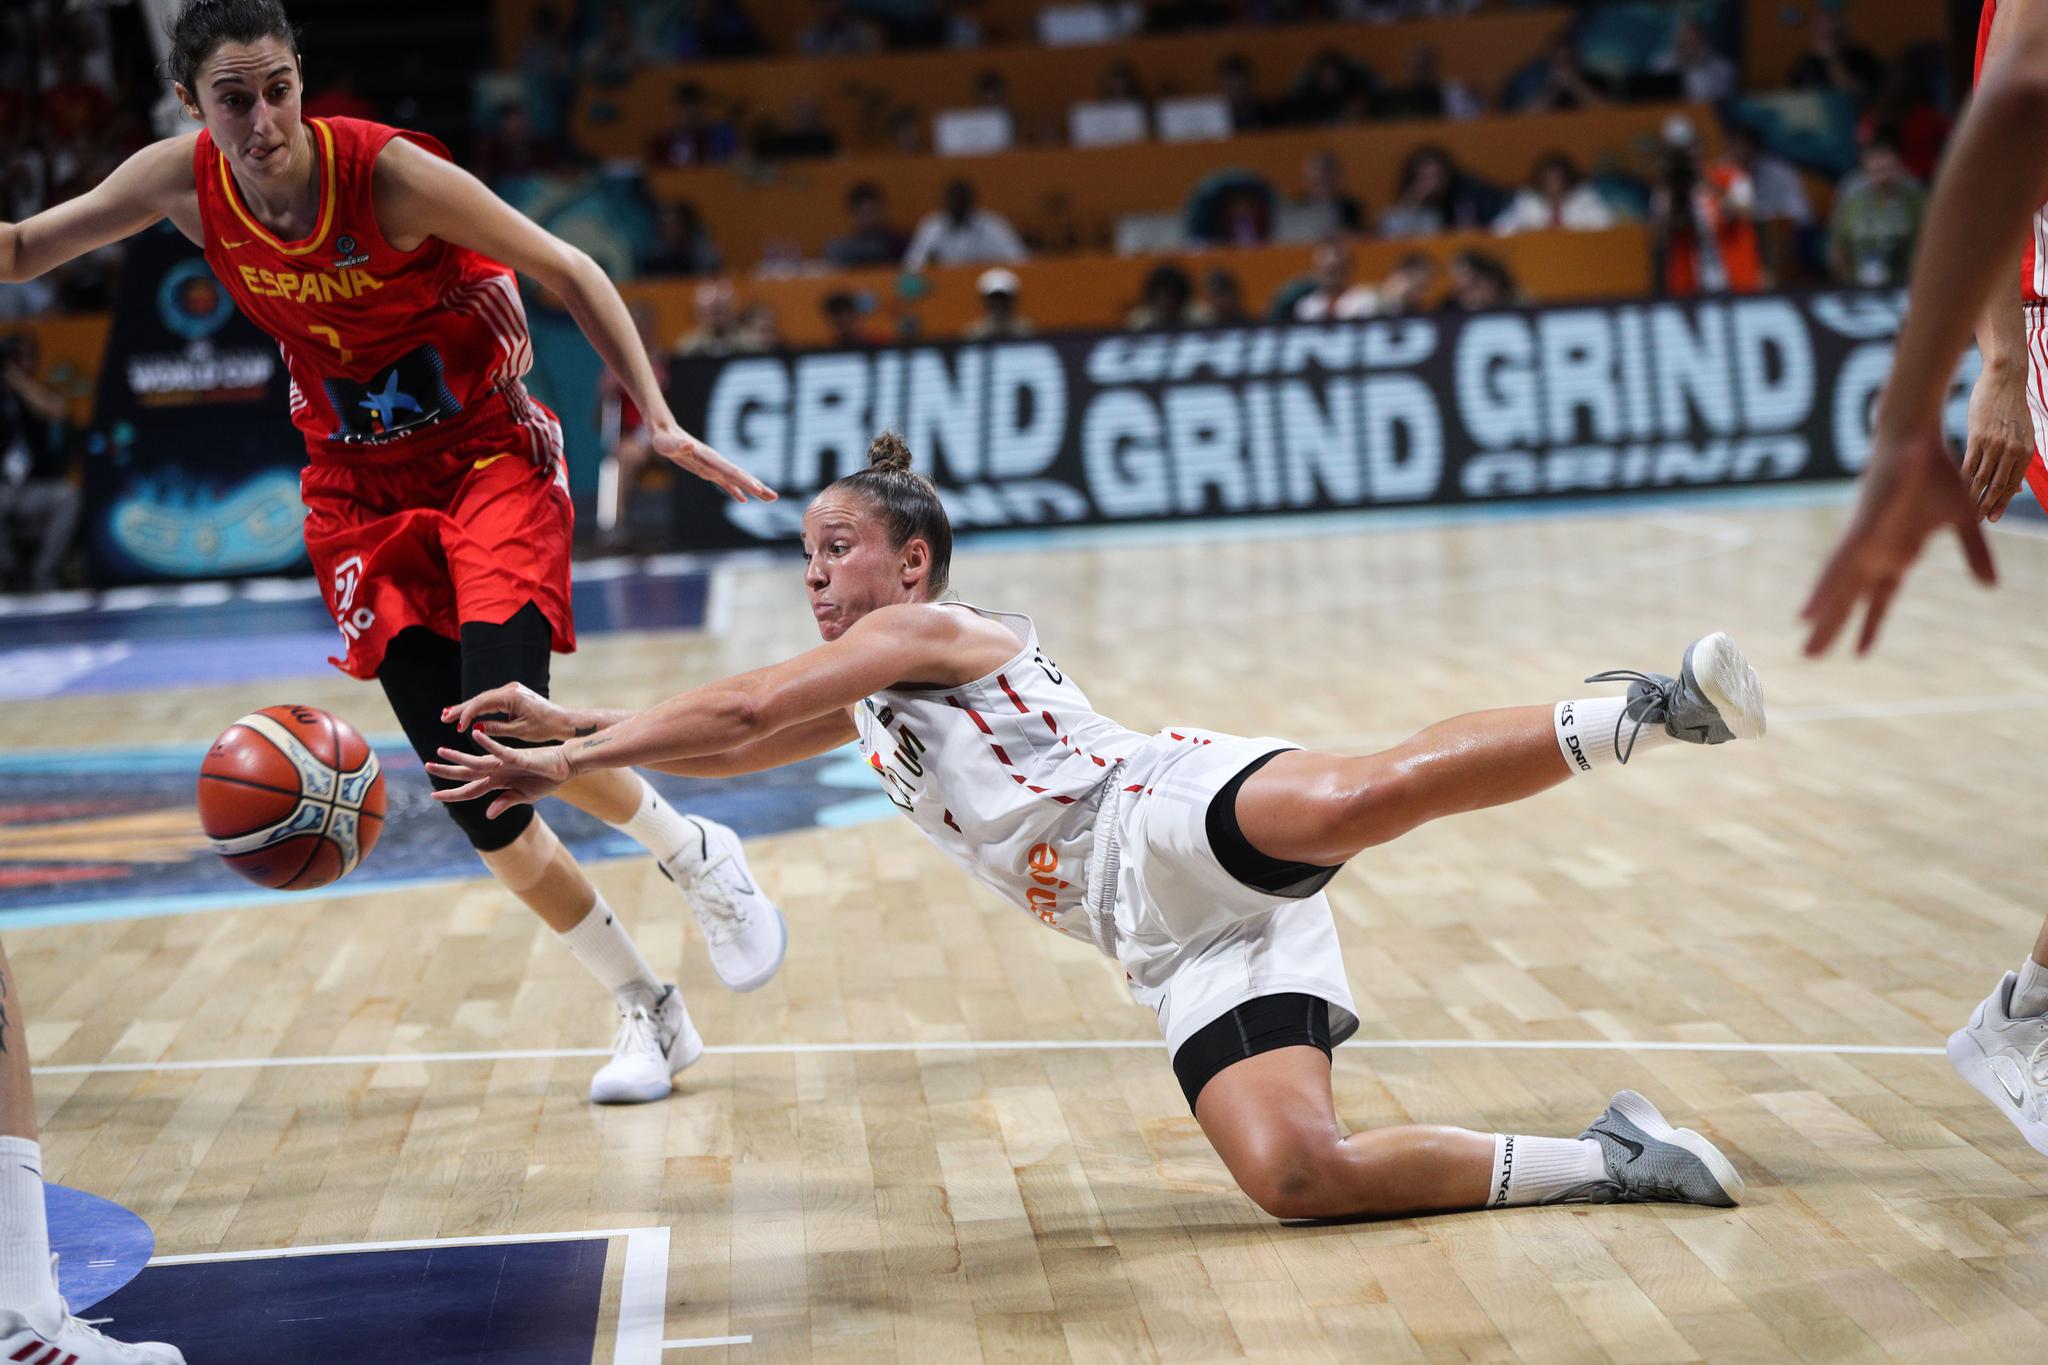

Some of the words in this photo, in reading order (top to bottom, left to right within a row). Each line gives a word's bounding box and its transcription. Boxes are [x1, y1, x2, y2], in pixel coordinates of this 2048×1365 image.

[238, 264, 384, 303] ESPAÑA
[705, 339, 1068, 492] GRIND
[1081, 371, 1444, 518] GRIND
[1455, 298, 1815, 448] GRIND
